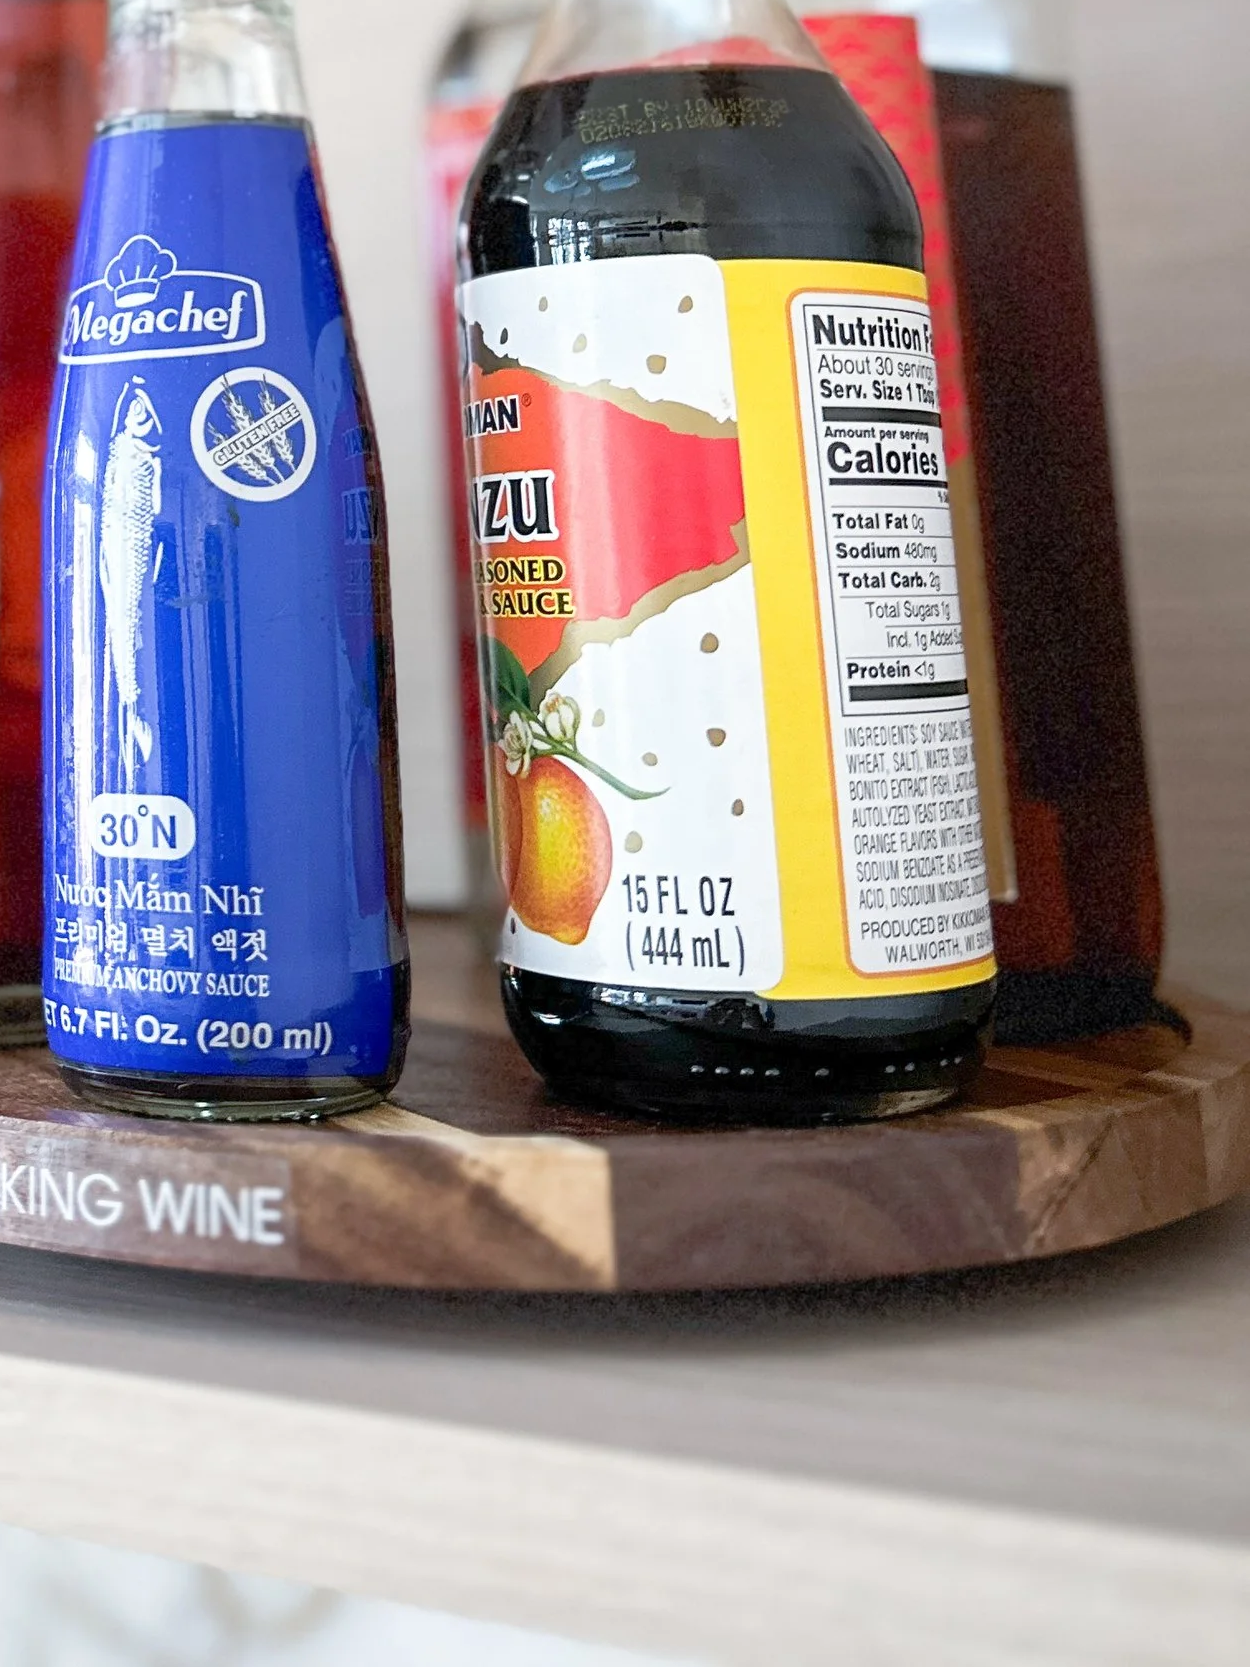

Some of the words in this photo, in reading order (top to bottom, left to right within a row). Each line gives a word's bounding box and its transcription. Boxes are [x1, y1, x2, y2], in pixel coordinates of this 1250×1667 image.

[66, 290, 247, 346] Megachef
[812, 314, 920, 352] Nutrition
[818, 353, 871, 375] About
[875, 356, 893, 377] 30
[820, 378, 867, 400] Serv.
[872, 379, 902, 401] Size
[906, 383, 913, 402] 1
[213, 424, 269, 466] GLUTEN
[267, 403, 301, 434] FREE
[824, 425, 876, 439] Amount
[880, 429, 897, 442] per
[900, 428, 929, 444] serving
[827, 441, 938, 476] Calories
[832, 513, 879, 530] Total
[885, 513, 909, 530] Fat
[835, 541, 900, 559] Sodium
[904, 542, 937, 563] 480mg
[838, 572, 886, 589] Total
[891, 570, 927, 589] Carb.
[492, 588, 573, 617] SAUCE
[865, 601, 901, 619] Total
[903, 600, 939, 621] Sugars
[887, 631, 911, 648] Incl.
[915, 629, 927, 651] 1g
[930, 629, 953, 647] Added
[847, 660, 911, 680] Protein
[915, 660, 935, 681] <1g
[844, 724, 918, 747] INGREDIENTS:
[921, 723, 937, 744] SOY
[846, 752, 890, 775] WHEAT,
[849, 779, 889, 801] BONITO
[891, 776, 928, 799] EXTRACT
[101, 804, 177, 849] 30°N
[852, 804, 910, 828] AUTOLYZED
[912, 802, 937, 824] YEAST
[854, 832, 897, 855] ORANGE
[900, 829, 938, 853] FLAVORS
[856, 859, 899, 883] SODIUM
[903, 854, 945, 880] BENZOATE
[201, 884, 264, 916] Nhĩ
[622, 874, 649, 914] 15
[657, 875, 688, 915] FL
[699, 877, 735, 917] OZ
[859, 887, 888, 911] ACID,
[890, 882, 936, 909] DISODIUM
[861, 917, 935, 940] PRODUCED
[938, 914, 952, 934] BY
[141, 924, 195, 959] 멸치
[212, 928, 268, 962] 액젓
[885, 936, 963, 964] WALWORTH,
[113, 965, 202, 995] ANCHOVY
[206, 974, 270, 998] SAUCE
[60, 1005, 88, 1036] 6.7
[135, 1015, 187, 1046] Oz.
[197, 1019, 273, 1055] (200
[284, 1021, 333, 1056] ml)
[138, 1179, 285, 1245] WINE
